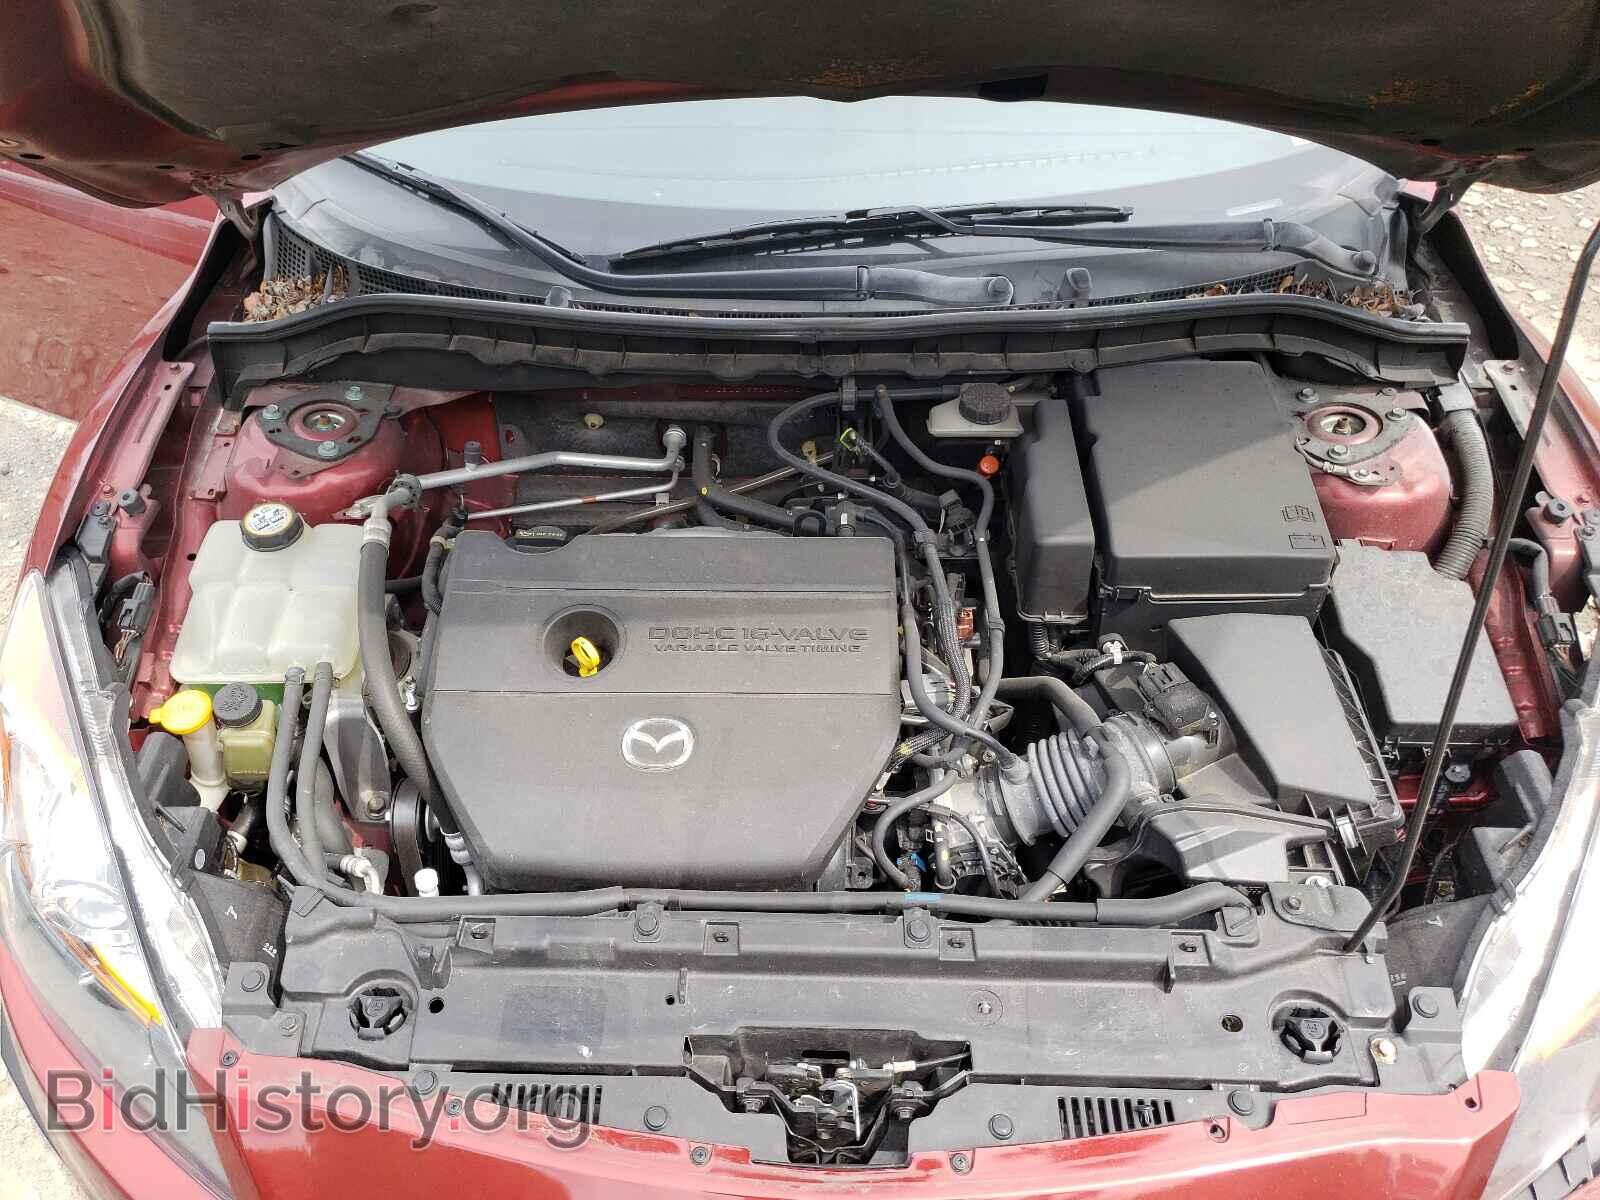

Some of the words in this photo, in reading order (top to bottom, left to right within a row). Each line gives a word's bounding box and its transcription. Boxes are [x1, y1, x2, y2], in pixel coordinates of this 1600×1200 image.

[648, 626, 737, 641] DOHC
[742, 626, 870, 642] 16-VALVE
[654, 643, 739, 653] VARIABLE
[743, 643, 797, 654] VALVE
[800, 644, 863, 654] TIMING
